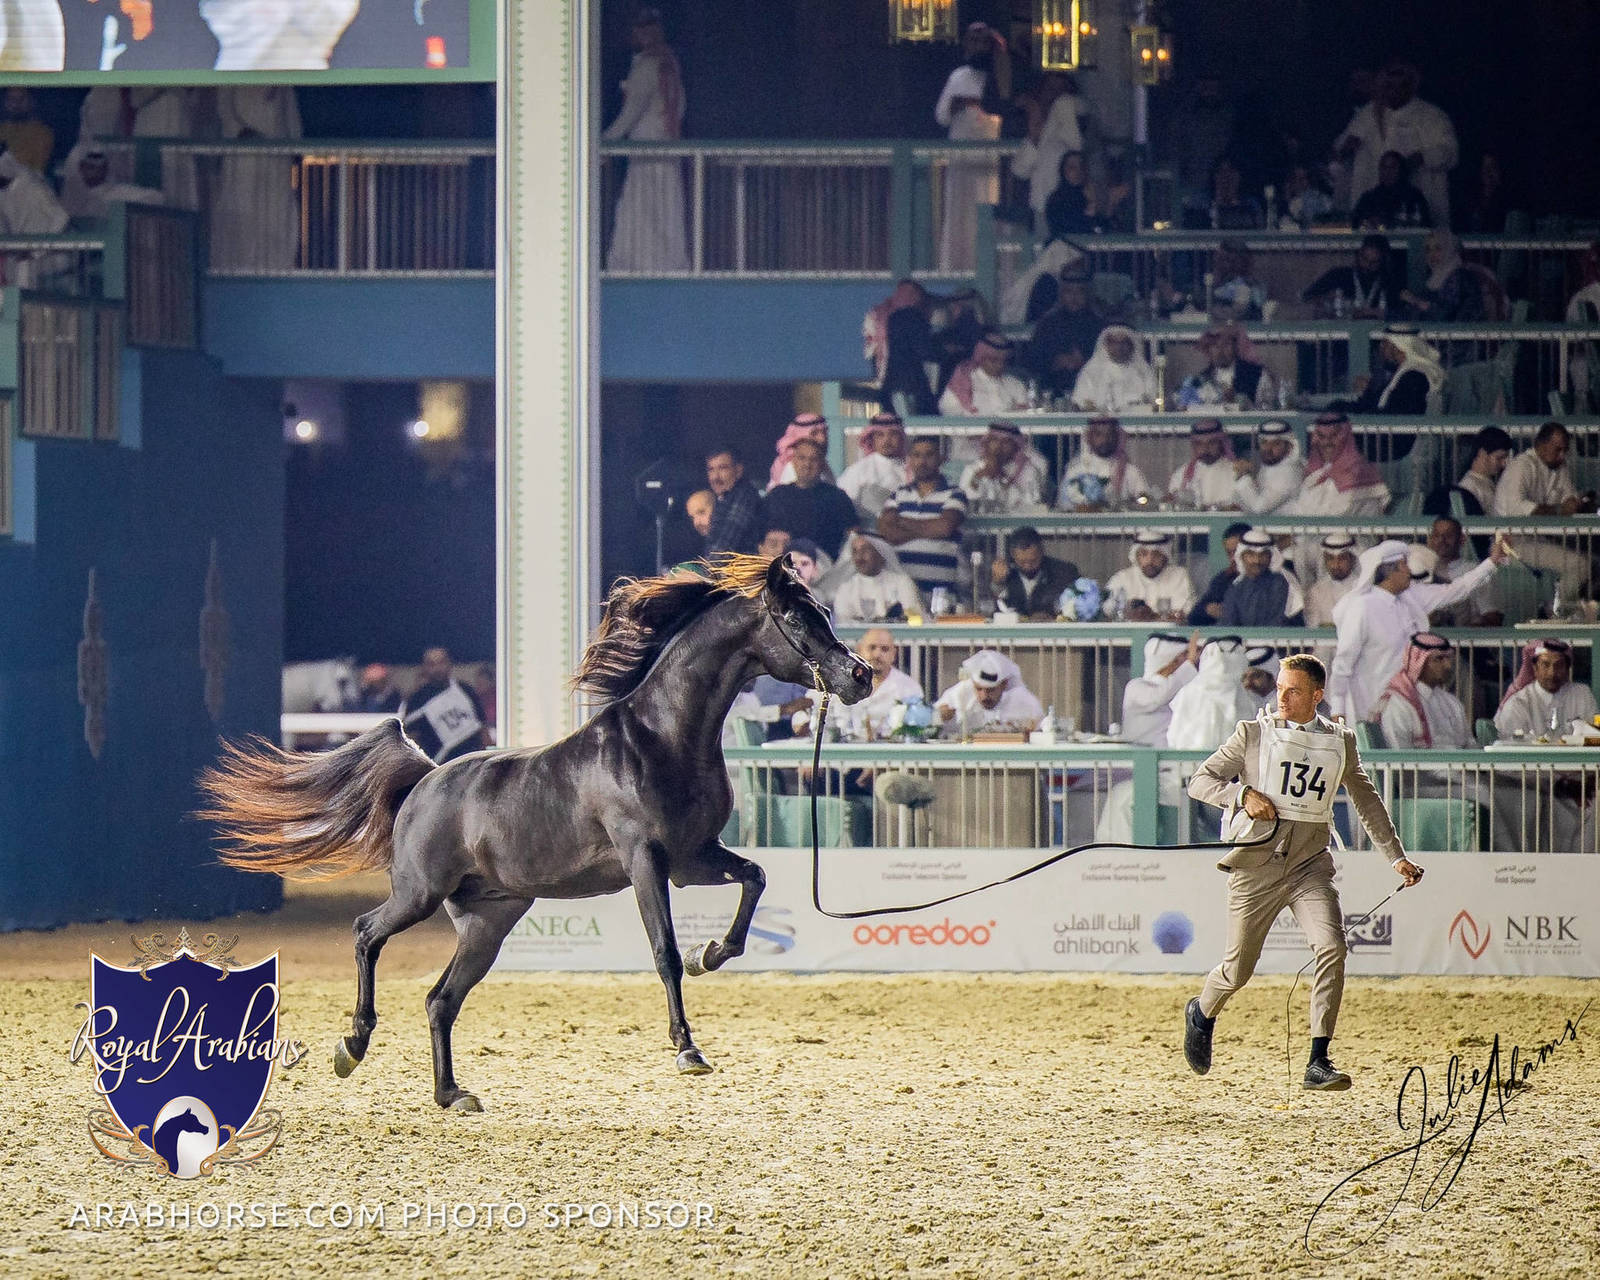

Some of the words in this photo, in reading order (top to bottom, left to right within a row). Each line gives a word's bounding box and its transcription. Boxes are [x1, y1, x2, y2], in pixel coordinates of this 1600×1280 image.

[1280, 761, 1326, 801] 134
[853, 917, 991, 946] ooredoo
[1505, 915, 1579, 941] NBK
[1053, 937, 1140, 955] ahlibank
